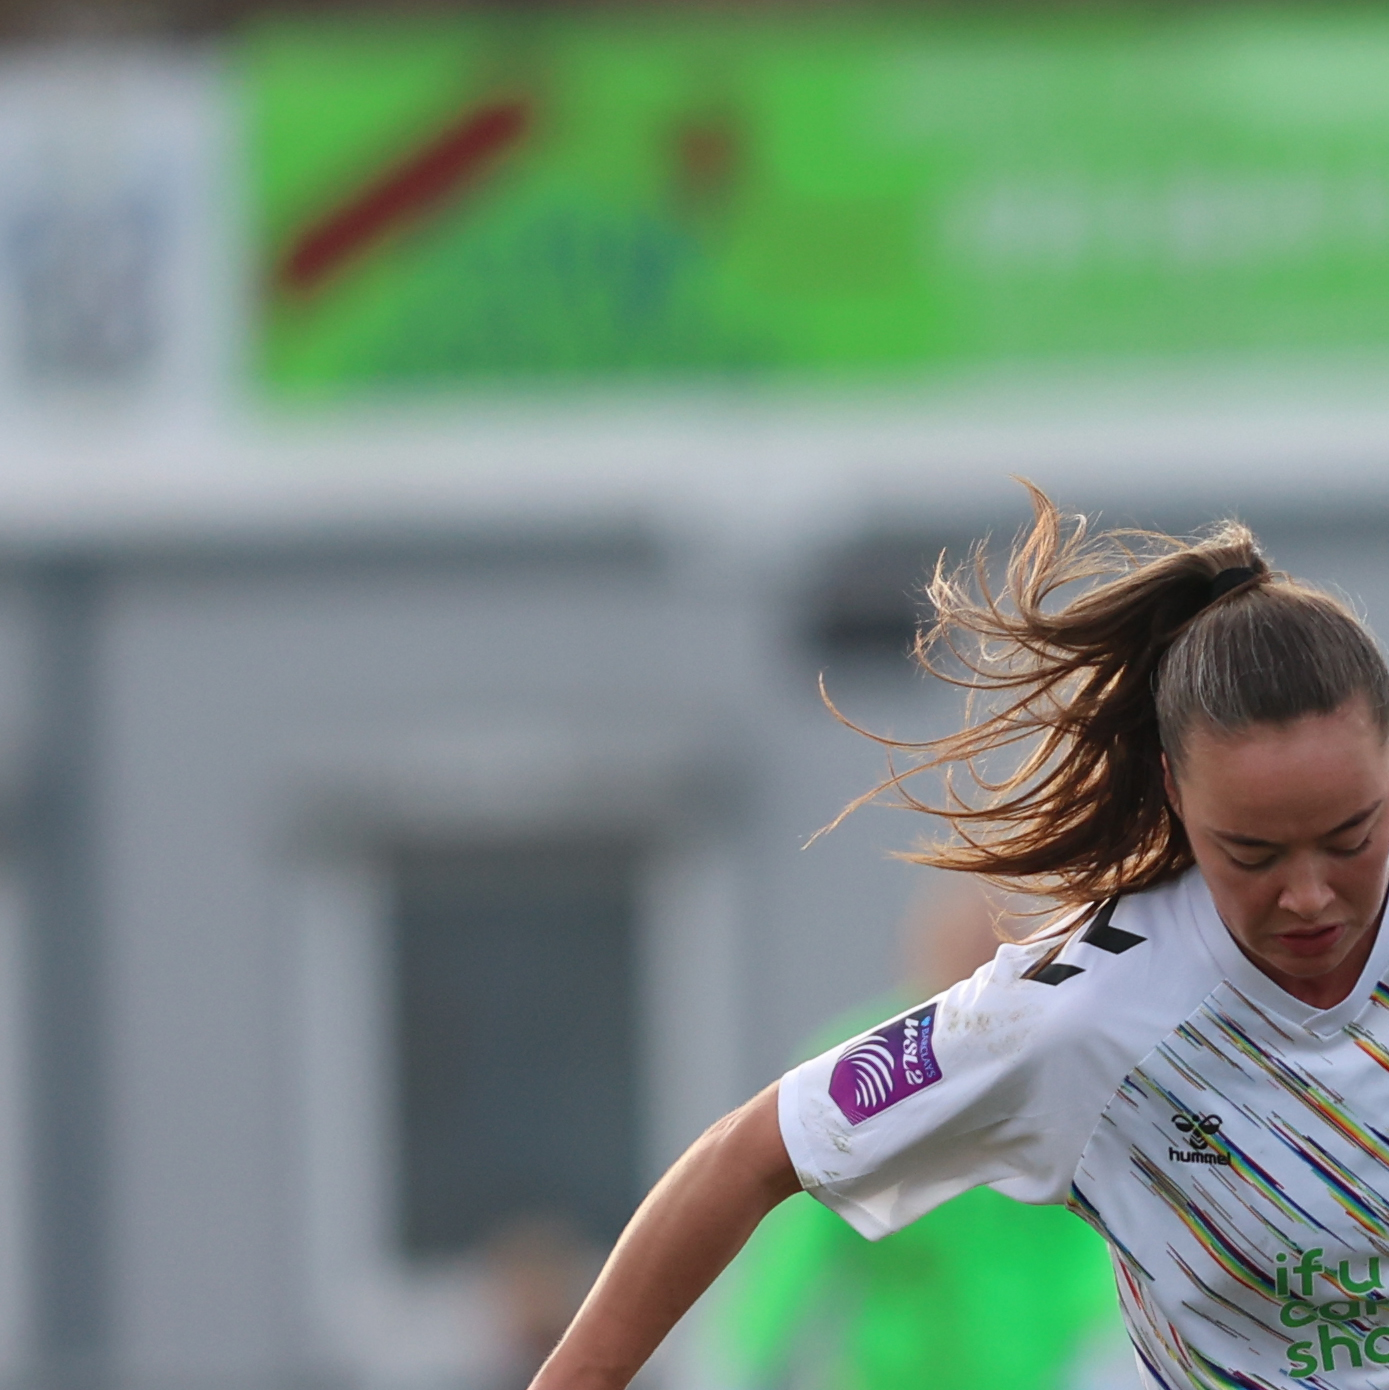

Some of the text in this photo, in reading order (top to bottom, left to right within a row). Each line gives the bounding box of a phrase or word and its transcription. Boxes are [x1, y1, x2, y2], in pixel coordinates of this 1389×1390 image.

[903, 1018, 924, 1085] WSL 2
[1168, 1146, 1231, 1166] hummel
[1275, 1247, 1385, 1297] if u
